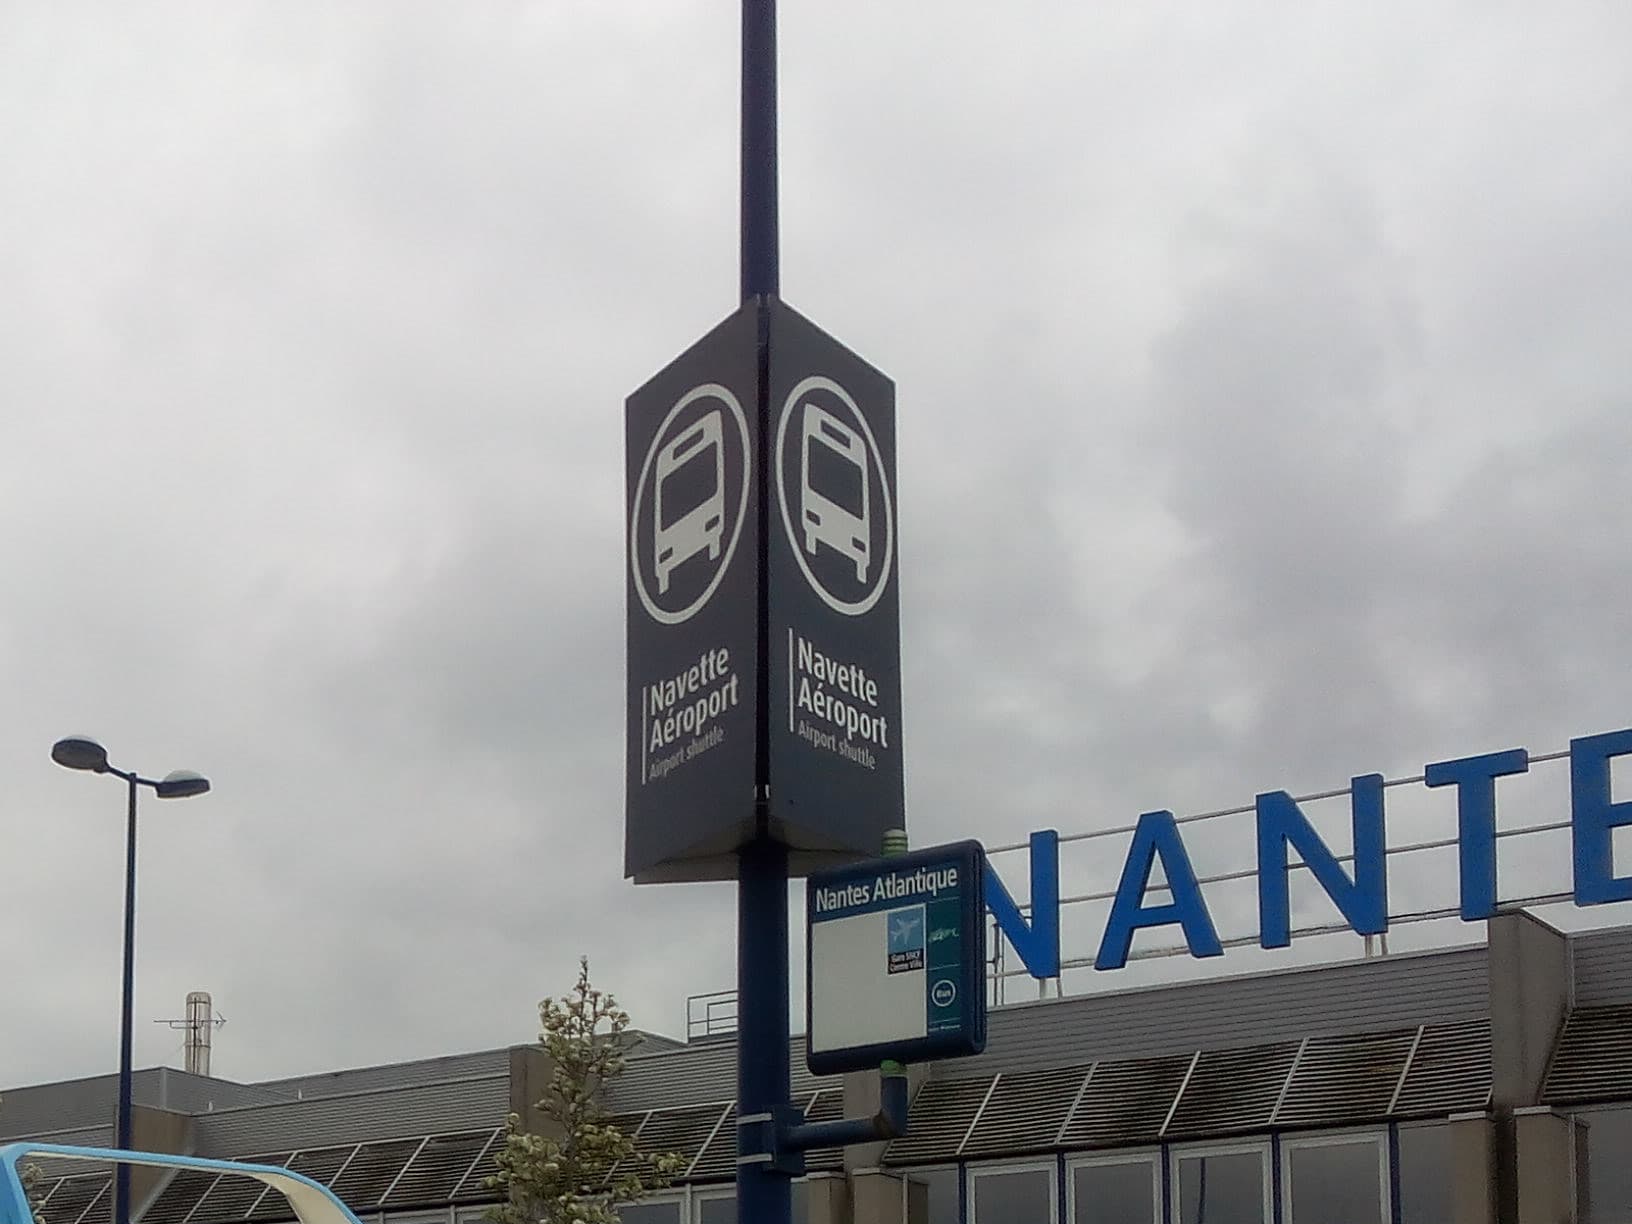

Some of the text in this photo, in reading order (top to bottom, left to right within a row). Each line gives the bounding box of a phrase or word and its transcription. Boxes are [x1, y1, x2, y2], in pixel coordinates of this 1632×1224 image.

[650, 647, 729, 716] Navette
[798, 636, 878, 707] Navette
[649, 673, 739, 753] Aéroport
[797, 677, 888, 749] Aéroport
[798, 719, 876, 770] Airport shuttle
[648, 725, 724, 782] Airport shuttle
[816, 866, 958, 913] Nantes Atlantique
